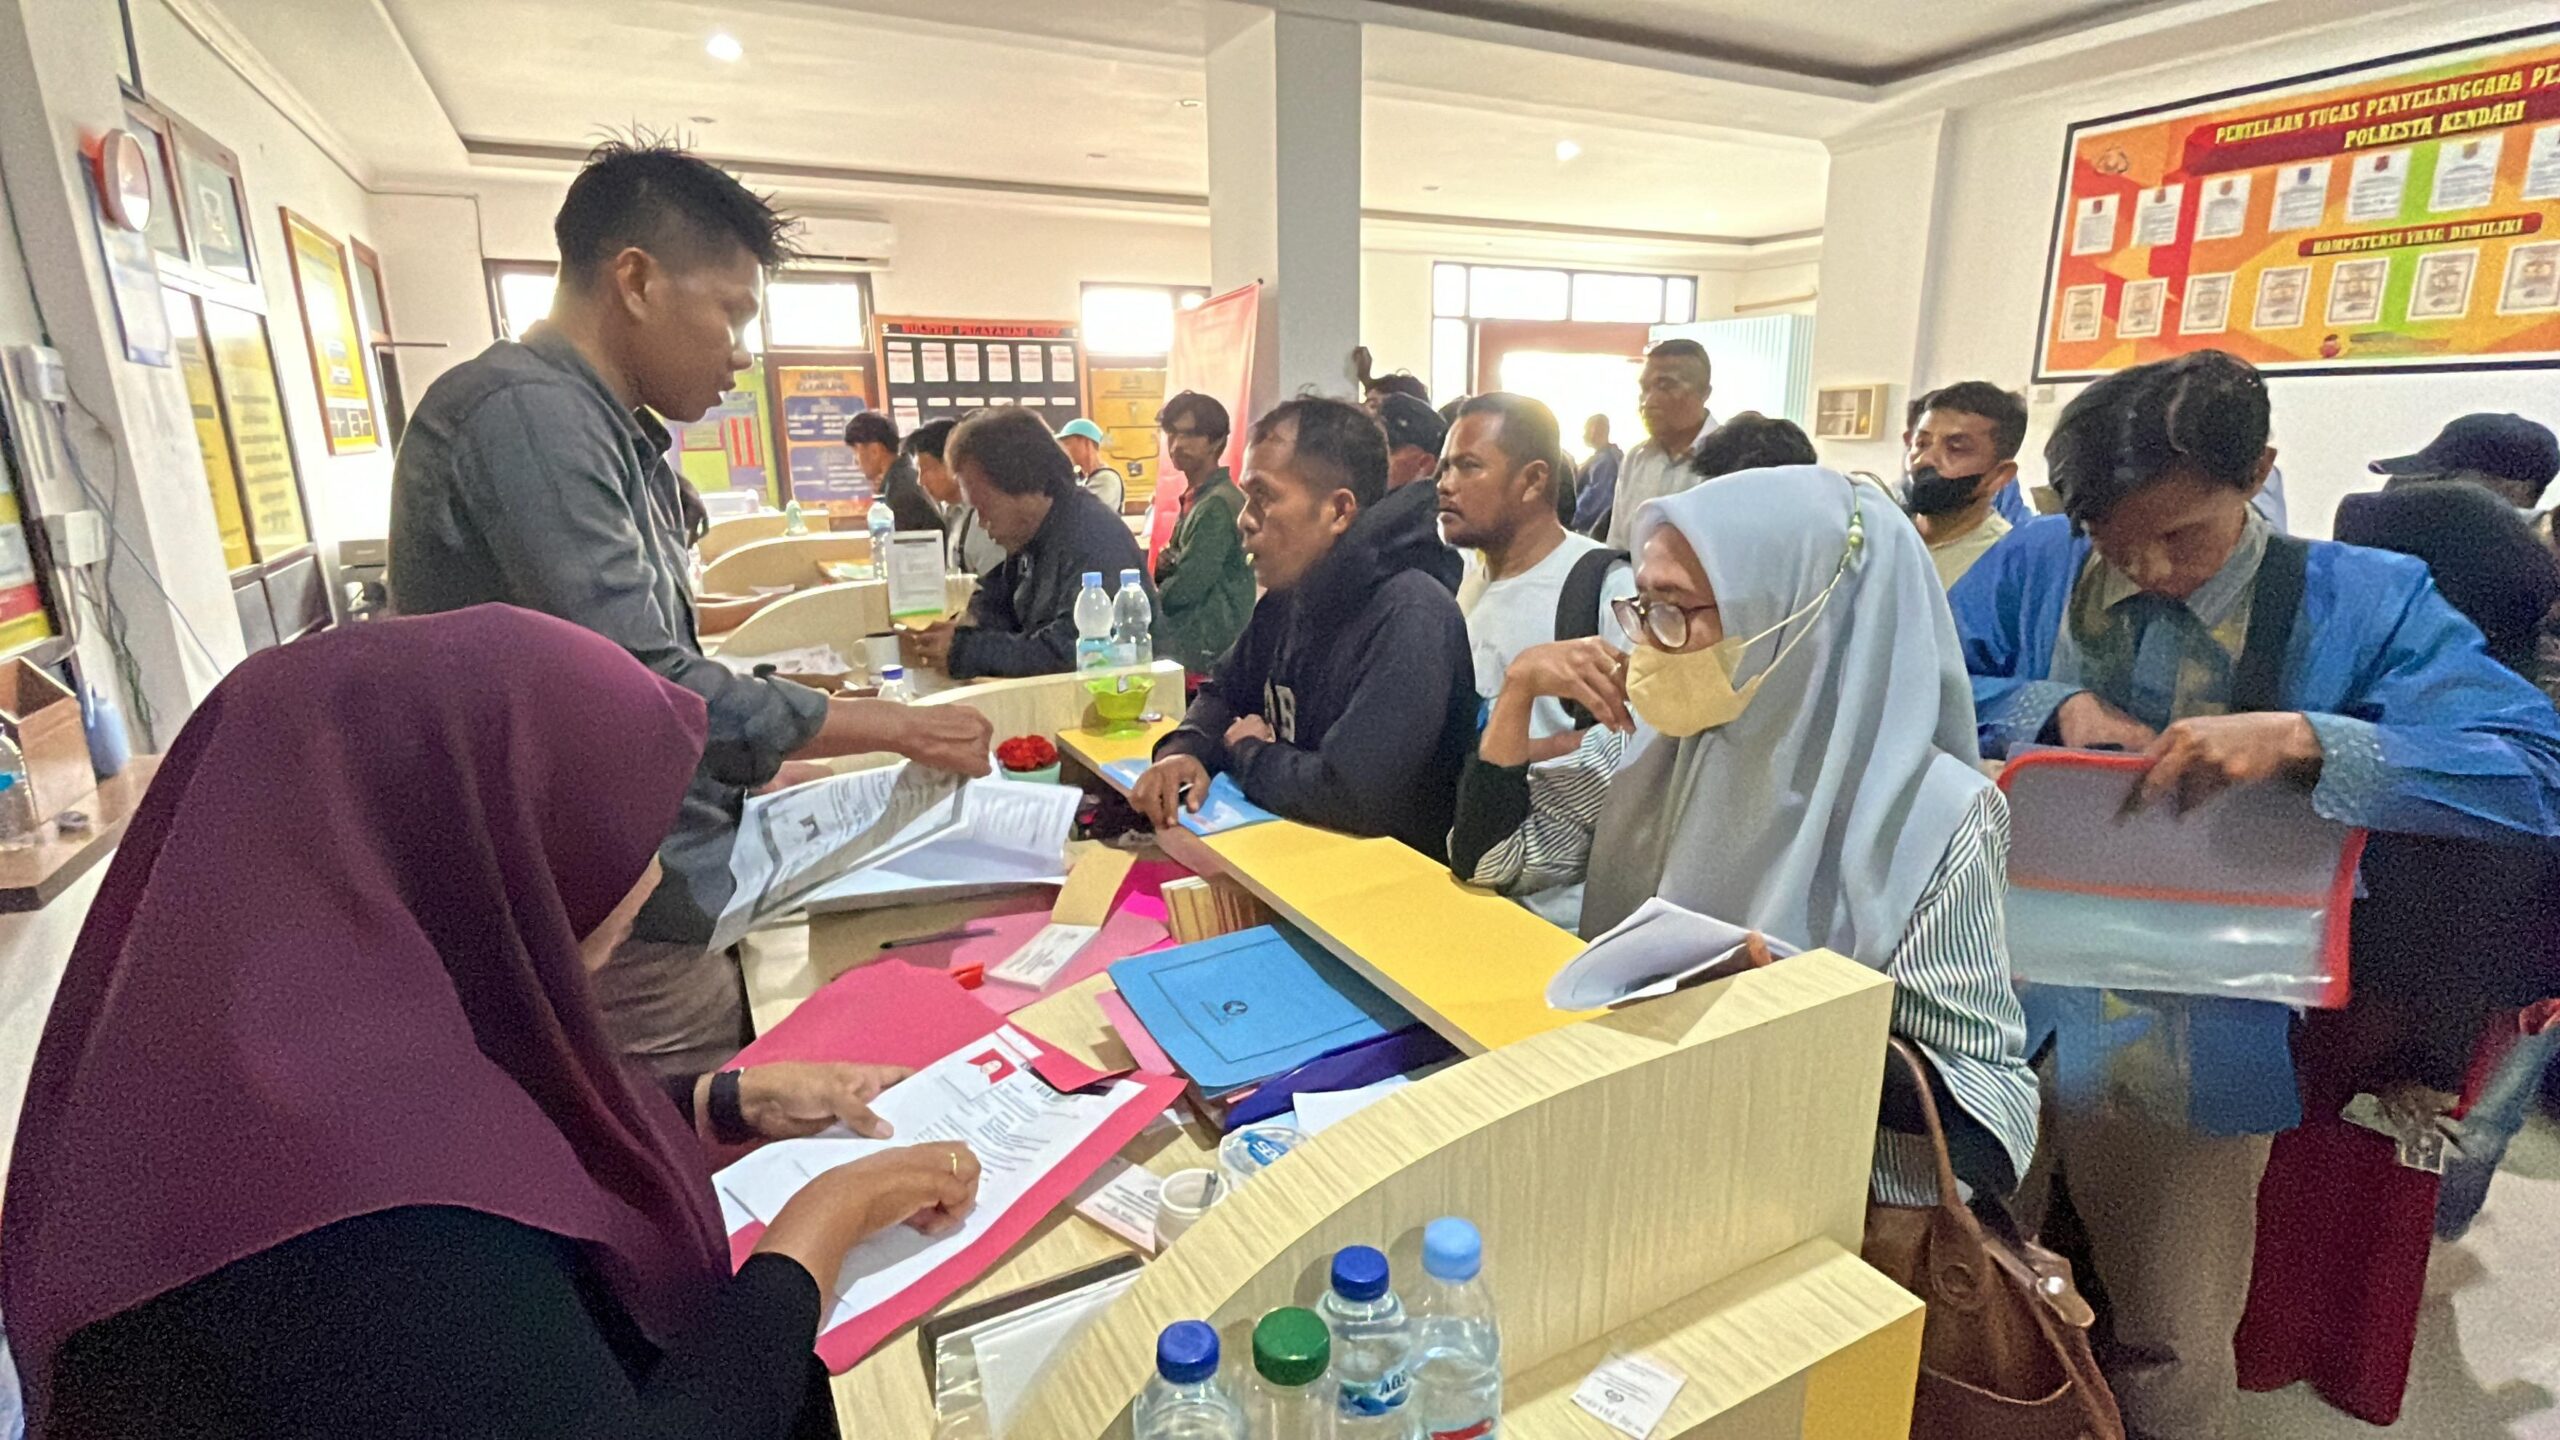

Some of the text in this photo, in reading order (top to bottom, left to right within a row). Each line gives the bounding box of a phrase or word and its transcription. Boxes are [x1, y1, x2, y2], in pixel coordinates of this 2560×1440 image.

[2309, 102, 2359, 127] TUGAS
[2366, 69, 2522, 116] PENYELENGGARA
[2530, 64, 2560, 88] PE
[2344, 101, 2526, 148] POLRESTA KENDARI
